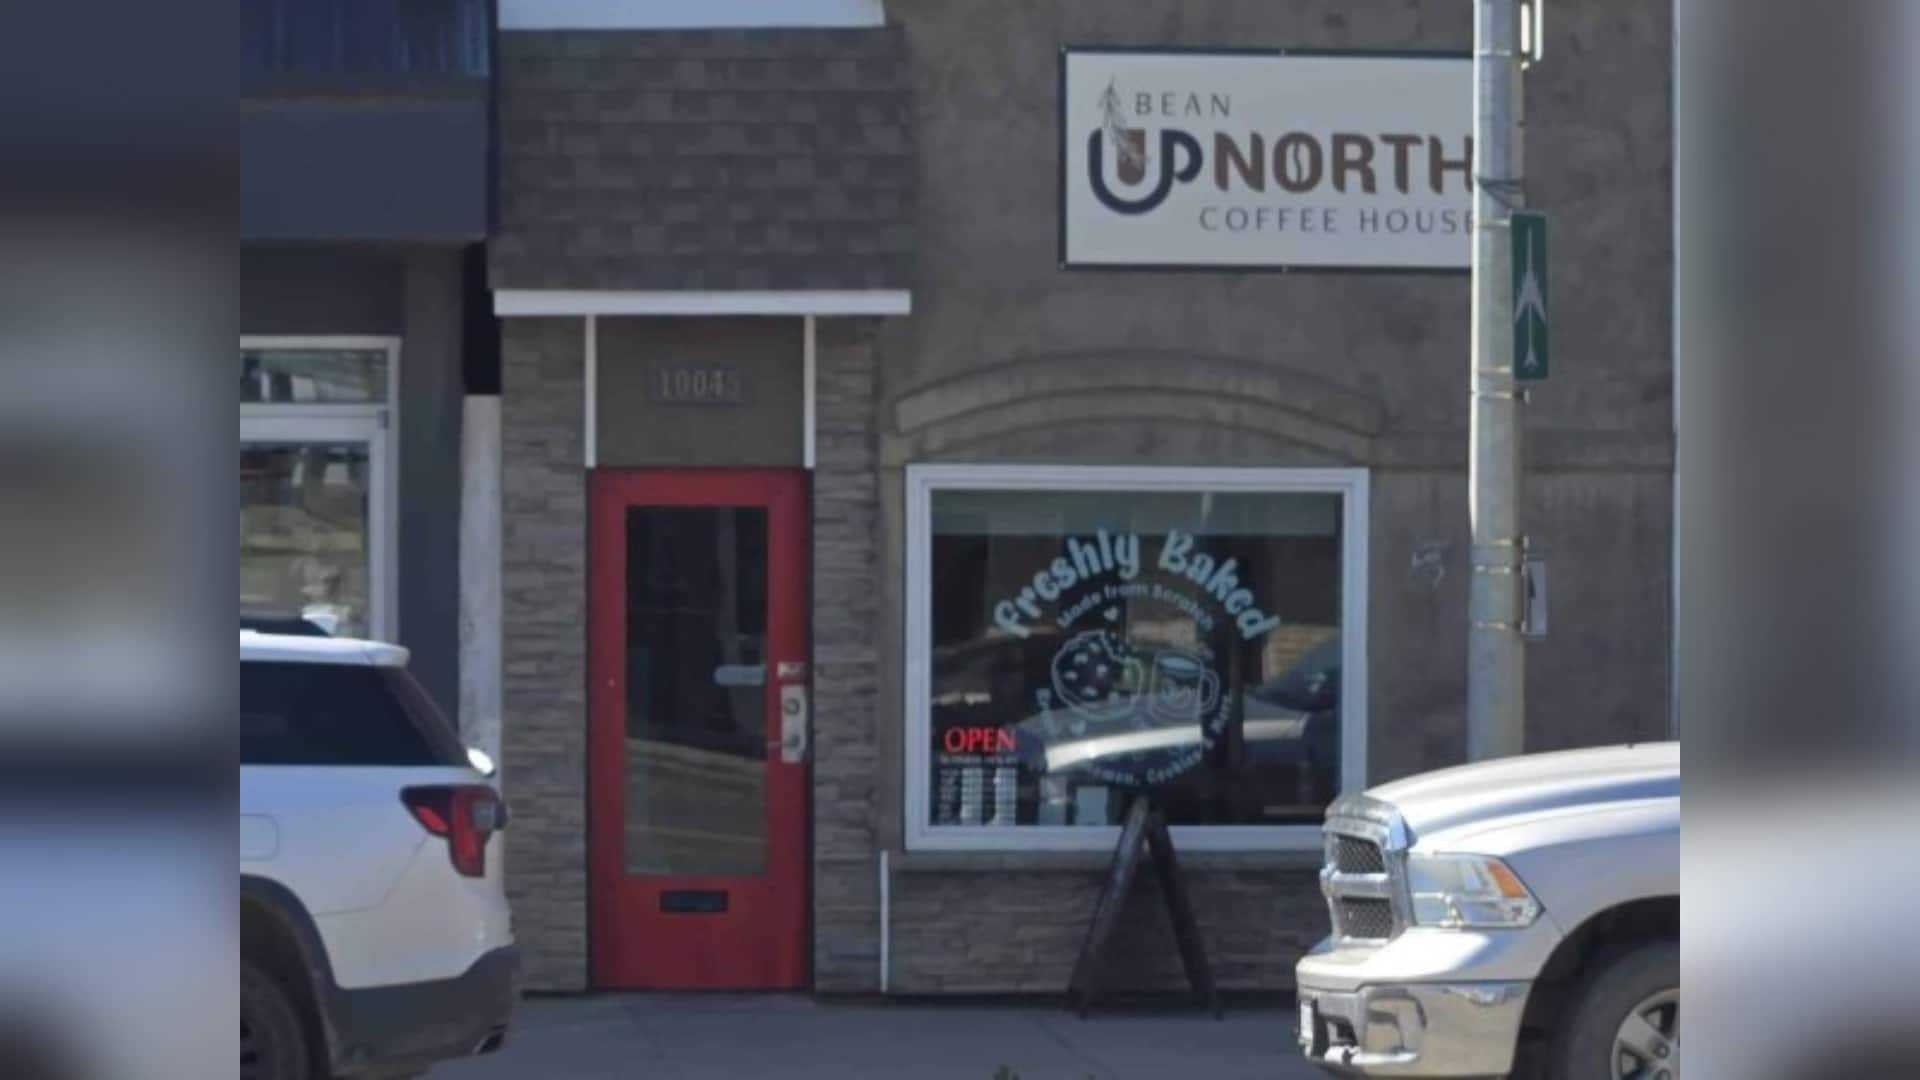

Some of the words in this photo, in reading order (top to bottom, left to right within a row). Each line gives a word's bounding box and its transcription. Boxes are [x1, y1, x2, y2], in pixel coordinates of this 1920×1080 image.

[1134, 92, 1231, 118] BEAN
[1087, 127, 1204, 216] UP
[1214, 130, 1474, 196] NORTH
[1199, 206, 1338, 233] COFFEE
[1157, 529, 1281, 640] Baked
[944, 727, 1017, 753] OPEN
